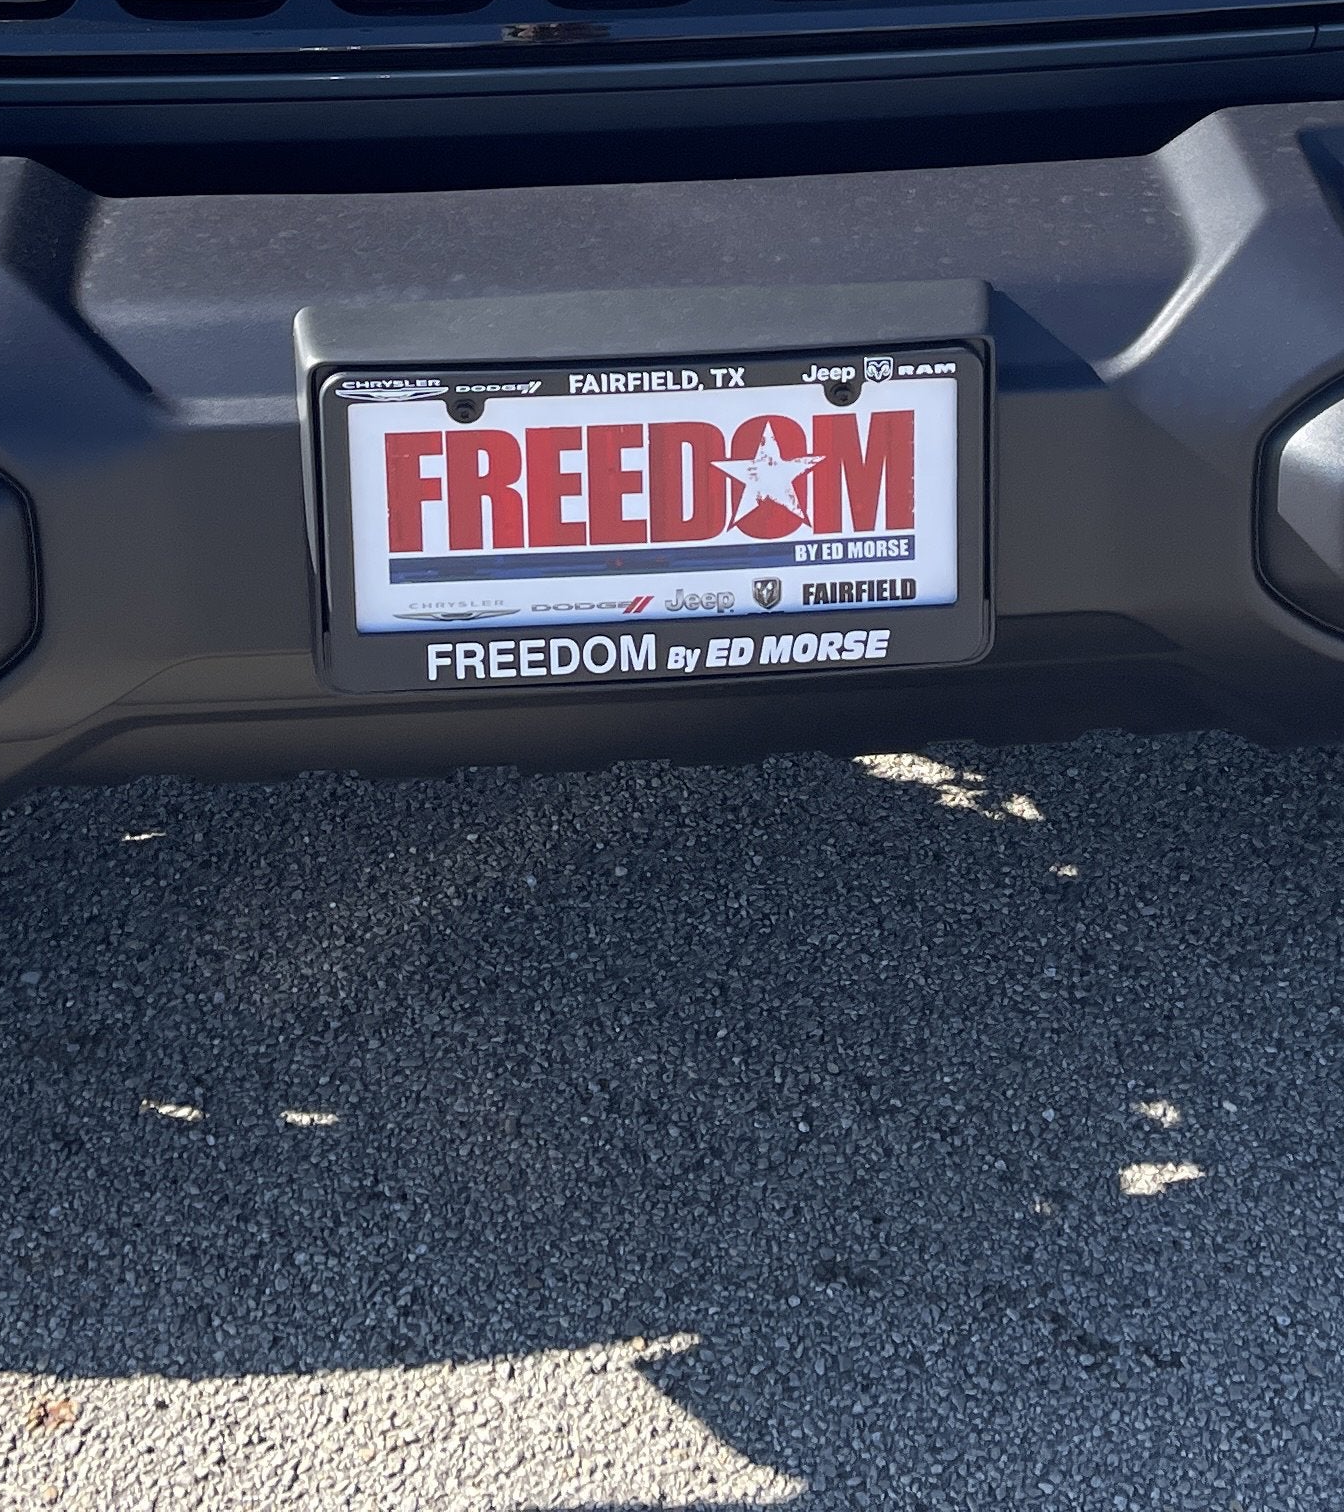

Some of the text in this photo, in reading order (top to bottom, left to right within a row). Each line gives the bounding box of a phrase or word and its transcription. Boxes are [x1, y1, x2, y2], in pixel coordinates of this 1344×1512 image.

[342, 362, 956, 394] CHRYSLER DODGE FAIRFIELD, TX Jeep RAM
[384, 409, 916, 553] FREEDOM
[794, 538, 909, 563] BY ED MORSE
[408, 577, 917, 614] CHRYSLER DODGE Jeep FAIRFIELD
[426, 629, 892, 681] FREEDOM By ED MORSE
